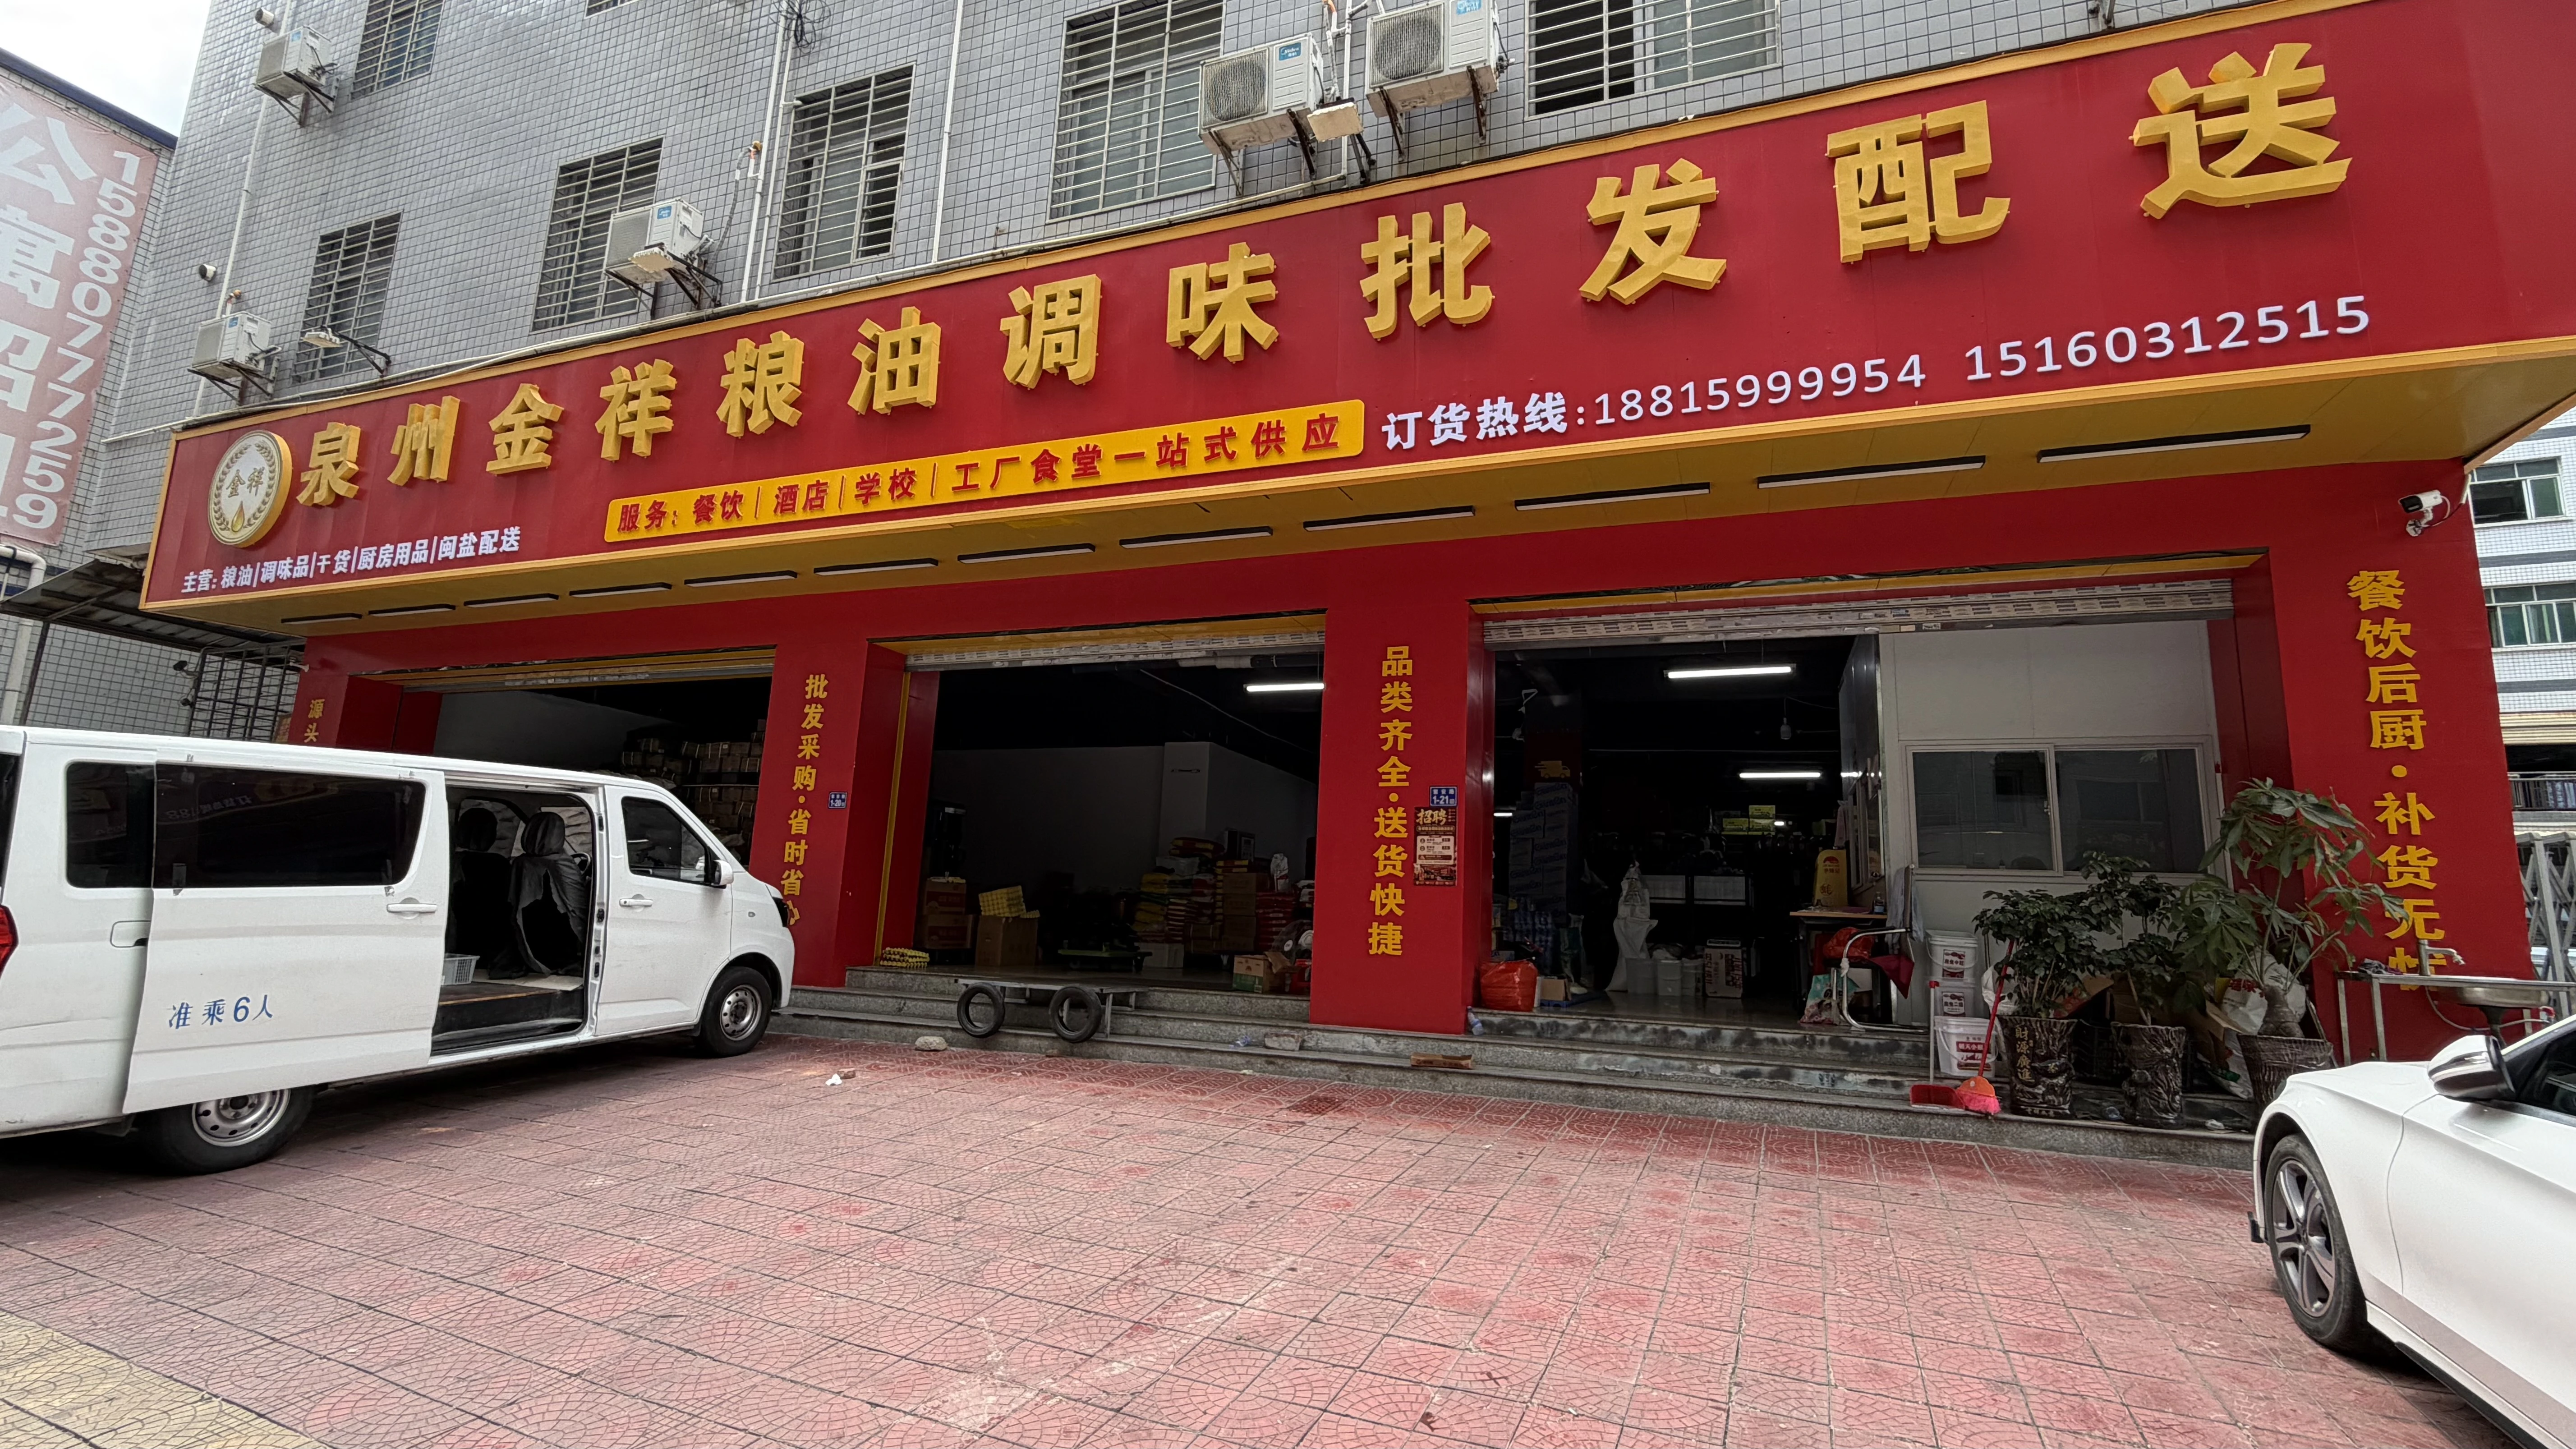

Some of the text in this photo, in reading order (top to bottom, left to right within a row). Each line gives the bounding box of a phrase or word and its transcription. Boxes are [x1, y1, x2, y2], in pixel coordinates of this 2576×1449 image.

[0, 103, 97, 517] 公寓
[12, 150, 141, 529] 15880777259
[295, 43, 2353, 506] 泉州金祥粮油调味批发配送
[1965, 295, 2369, 382] 15160312515
[304, 699, 325, 743] 源头
[1368, 645, 1413, 956] 品类齐全·送货快捷
[1416, 808, 1448, 826] 招聘
[168, 994, 273, 1030] 准乘6人
